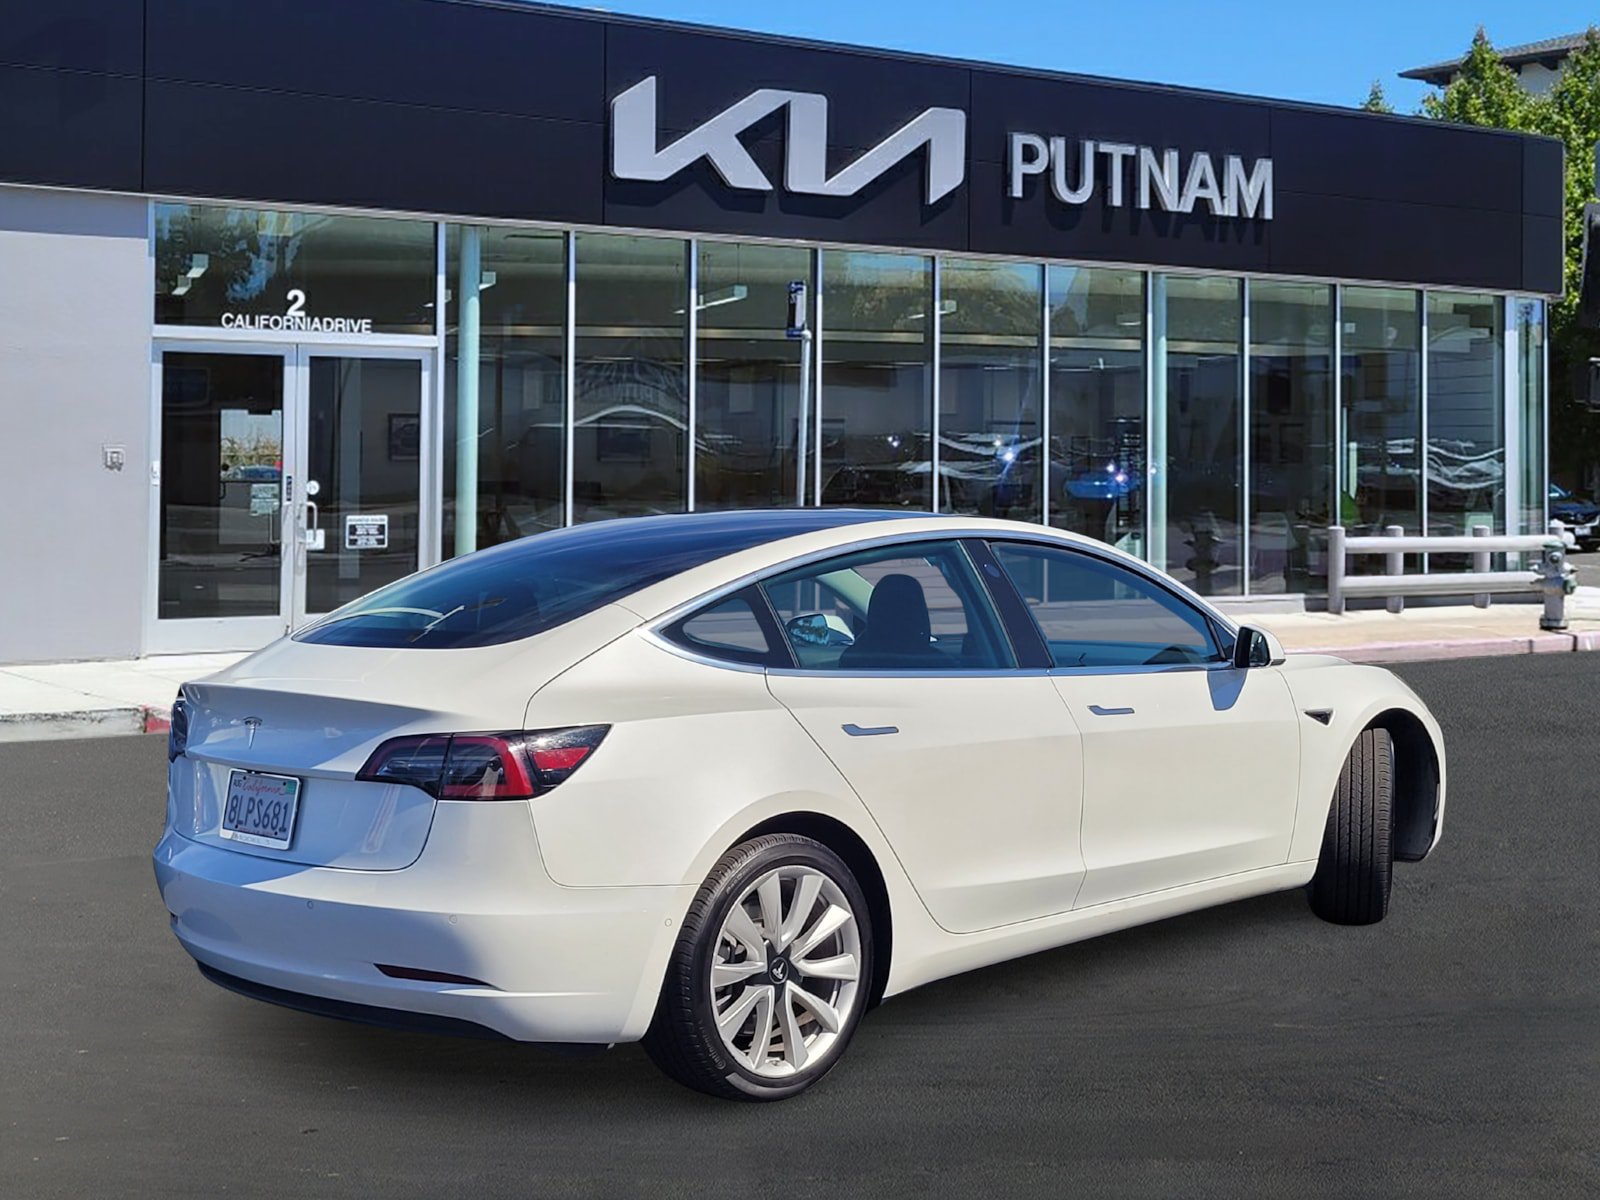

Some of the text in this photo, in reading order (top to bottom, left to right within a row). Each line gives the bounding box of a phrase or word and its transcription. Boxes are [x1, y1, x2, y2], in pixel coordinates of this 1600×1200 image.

[611, 75, 1274, 221] KIA PUTNAM
[286, 288, 306, 317] 2
[228, 794, 288, 832] 8LPS681
